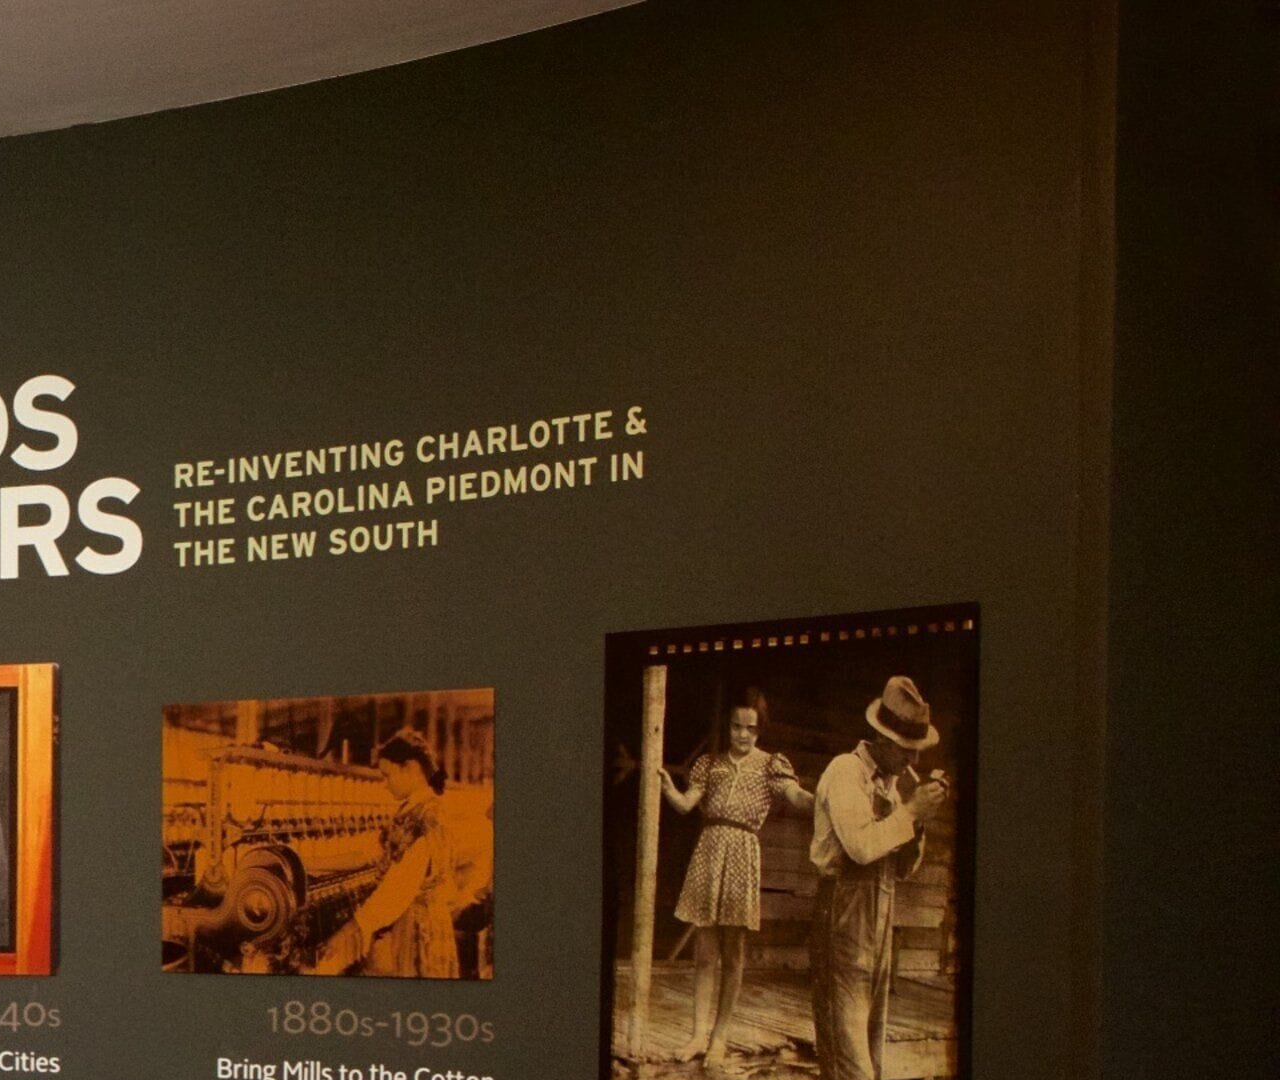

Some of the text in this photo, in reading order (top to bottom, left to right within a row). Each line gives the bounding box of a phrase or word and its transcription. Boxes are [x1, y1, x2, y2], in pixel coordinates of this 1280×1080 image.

[174, 406, 646, 488] RE-INVENTING CHARLOTTE &
[174, 451, 643, 527] THE CAROLINA PIEDMONT IN
[174, 520, 437, 567] THE NEW SOUTH
[267, 1000, 494, 1047] 1880s-1930s
